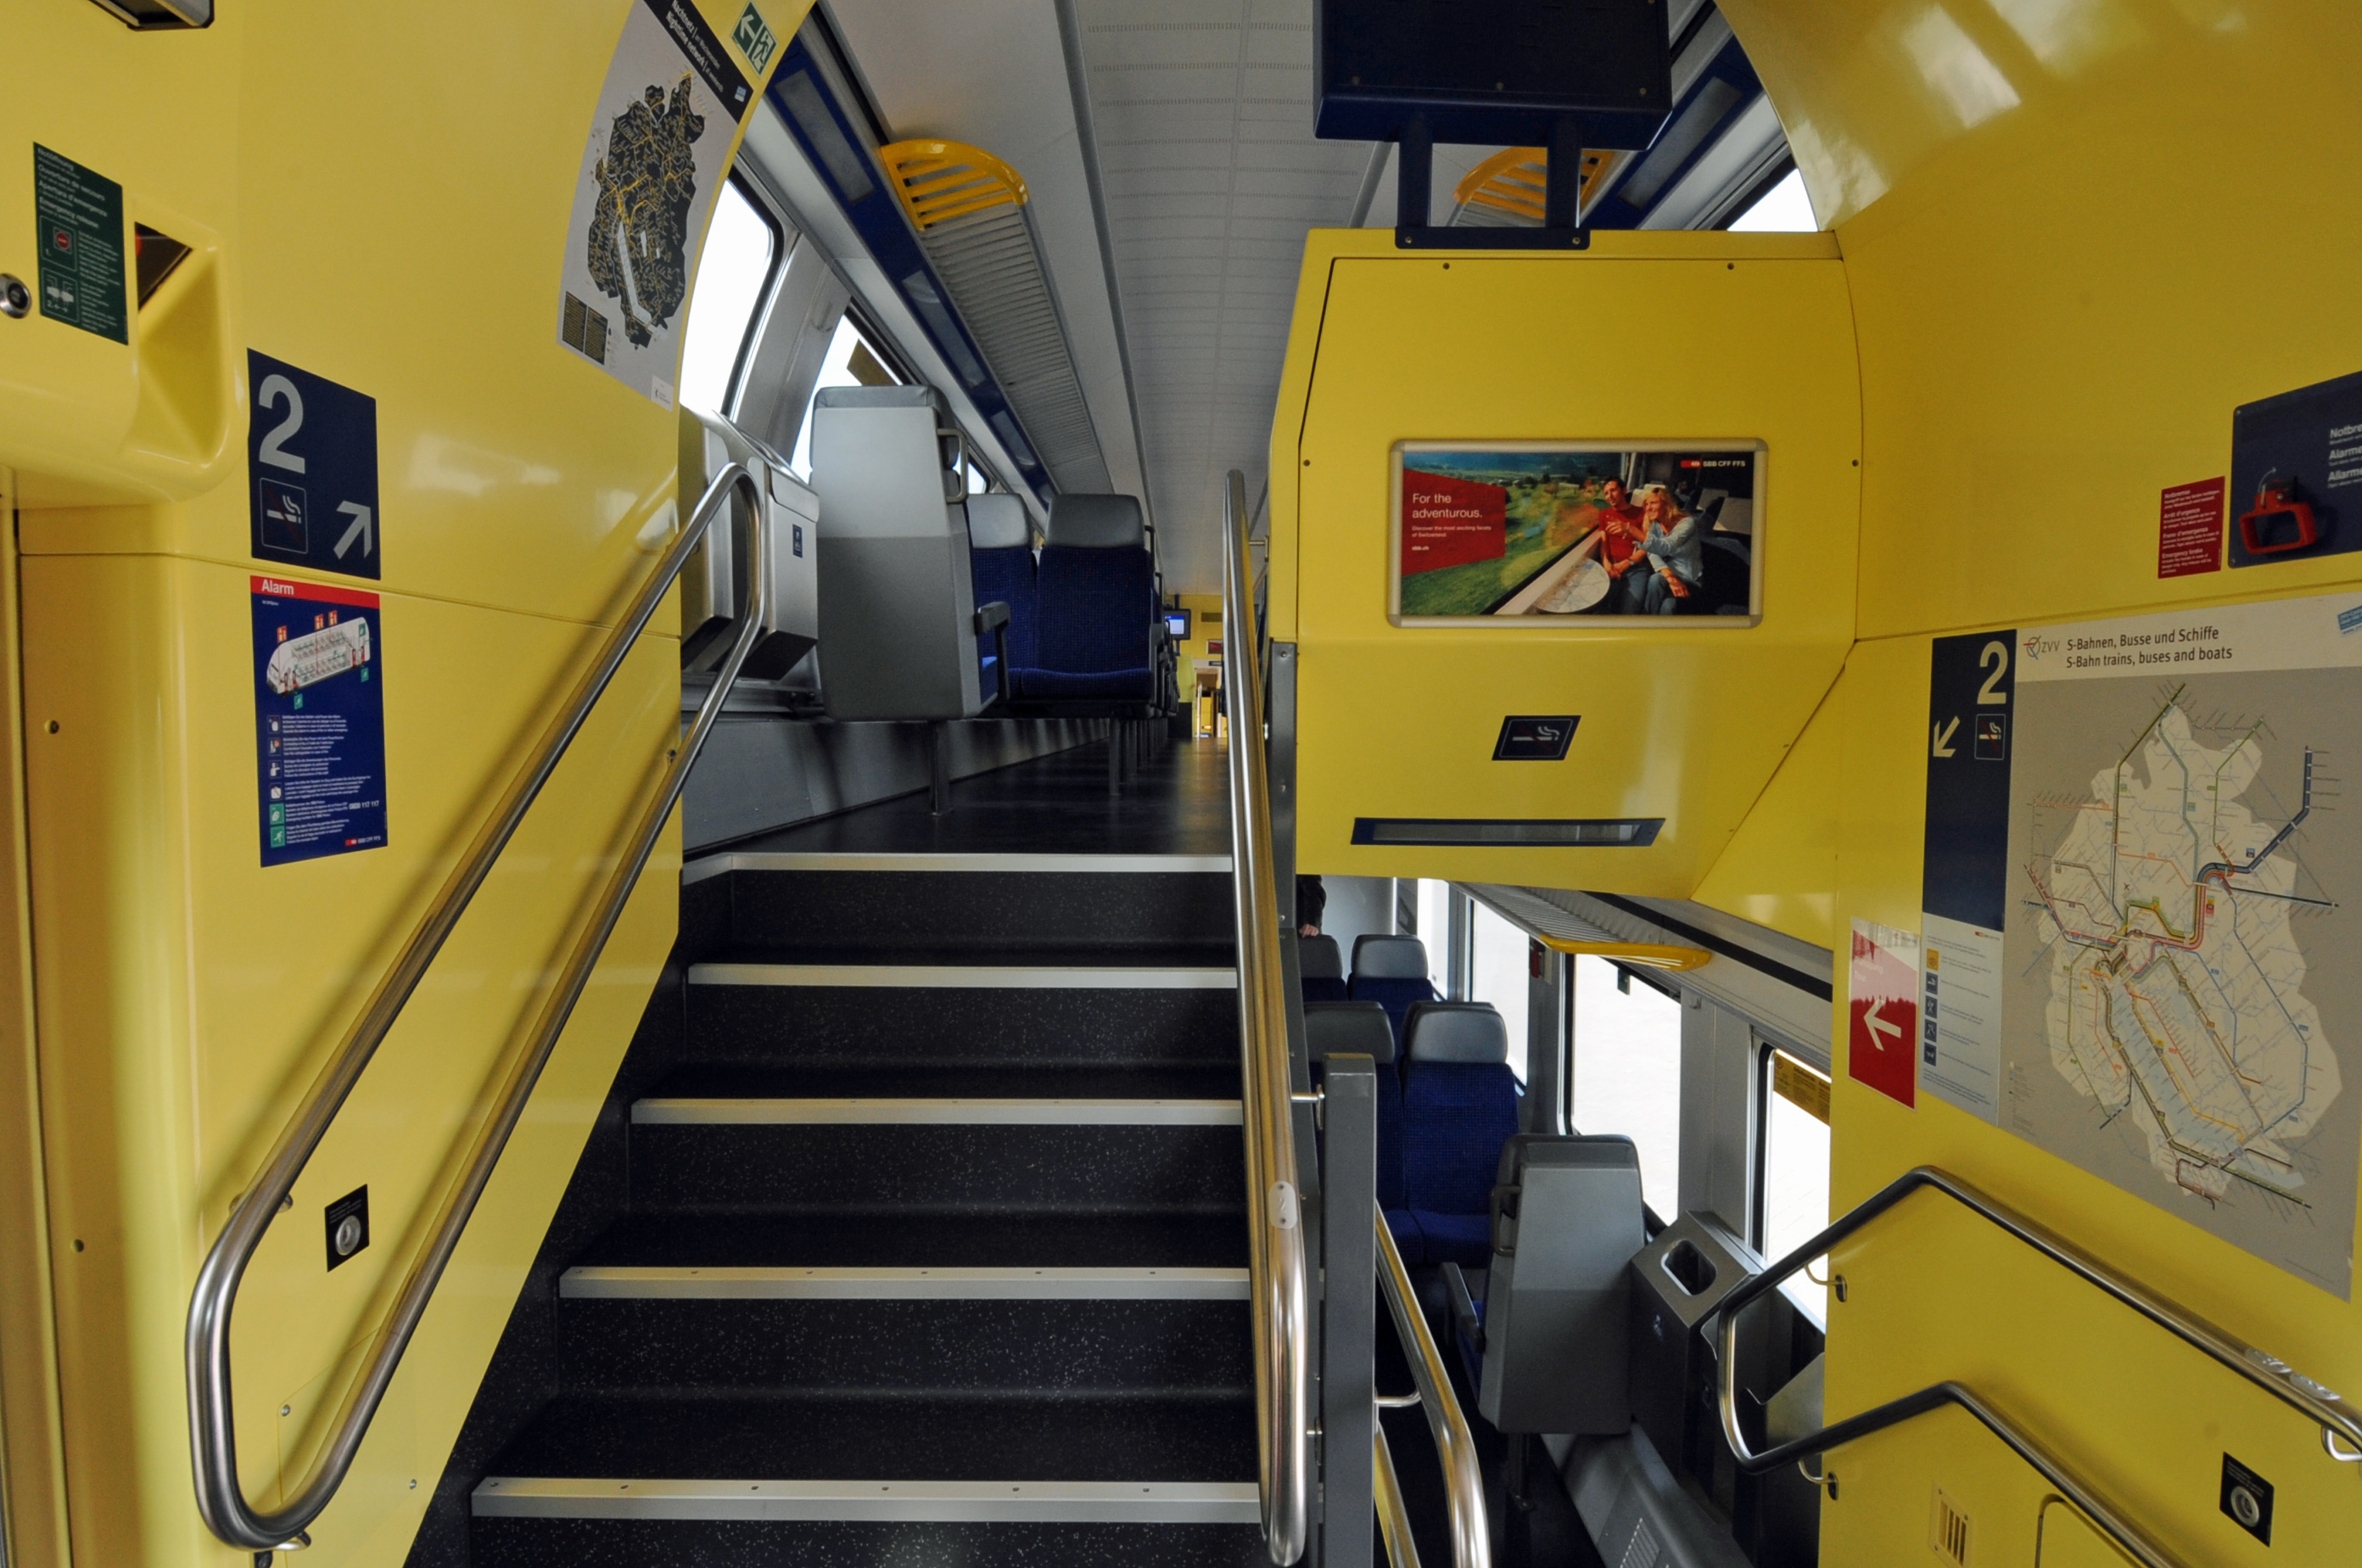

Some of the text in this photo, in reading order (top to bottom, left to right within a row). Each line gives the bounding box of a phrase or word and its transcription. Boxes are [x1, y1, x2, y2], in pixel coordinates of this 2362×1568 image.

[259, 373, 305, 474] 2
[1413, 493, 1452, 504] For the
[1412, 508, 1483, 518] adventurous.
[261, 579, 295, 596] Alarm
[2041, 641, 2060, 653] ZVV
[2067, 625, 2219, 651] S-Bahnen, Busse und Schiffe
[2066, 646, 2232, 669] S-Bahn trains, buses and boats
[1977, 641, 2008, 704] 2
